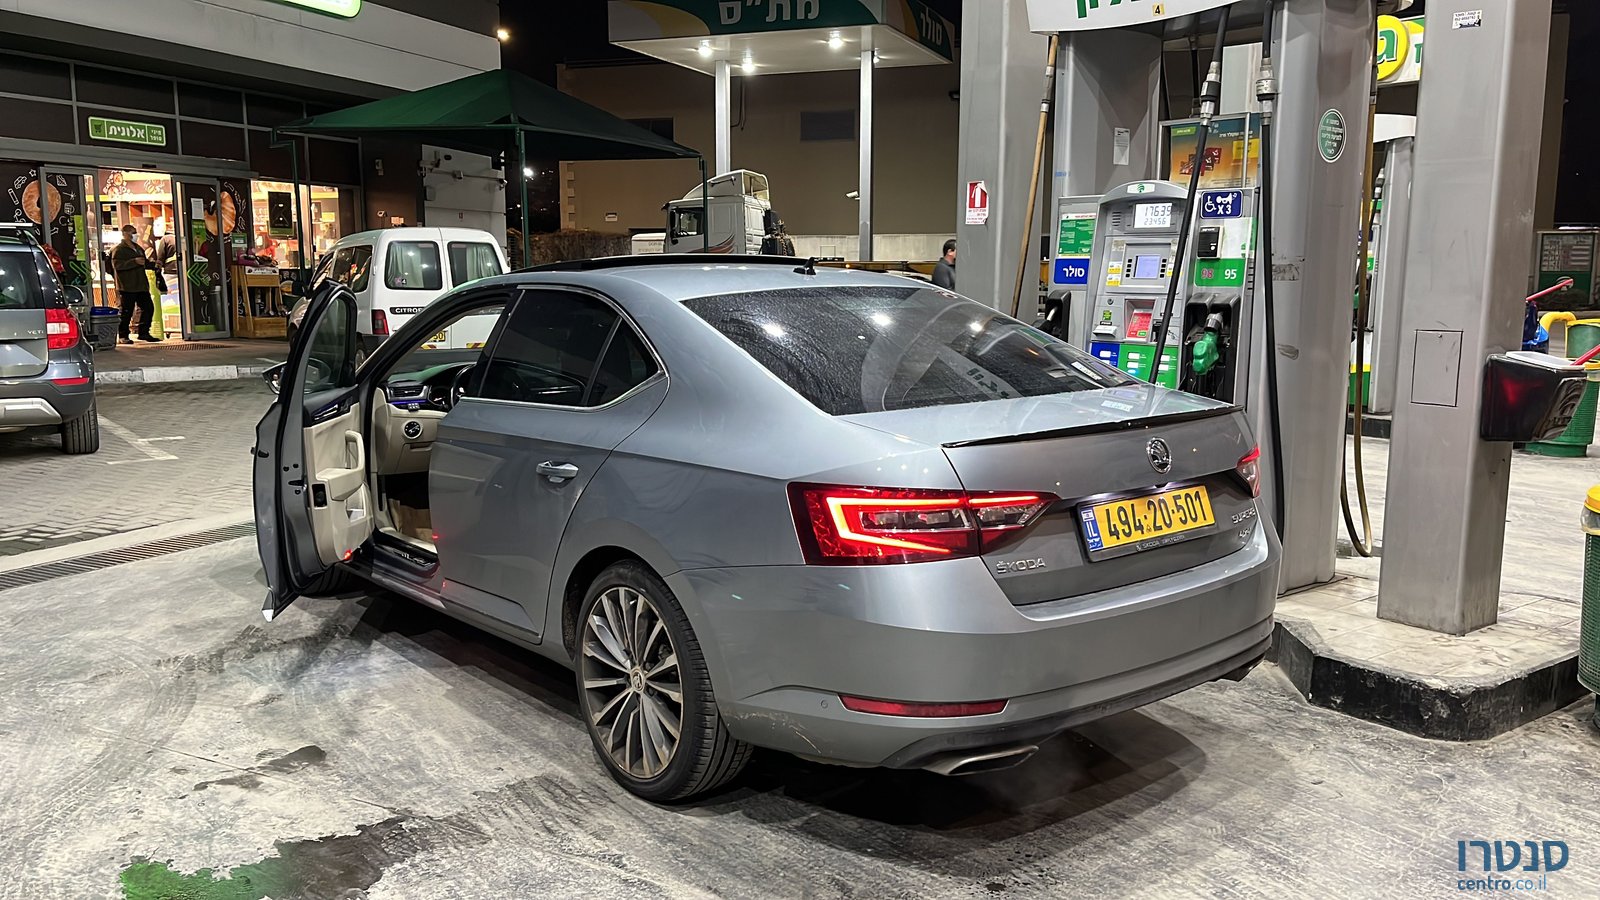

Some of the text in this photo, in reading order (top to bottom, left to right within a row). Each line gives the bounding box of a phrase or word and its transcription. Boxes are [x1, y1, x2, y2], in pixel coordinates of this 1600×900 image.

[1154, 5, 1161, 14] 4
[919, 7, 944, 46] סולר
[108, 125, 145, 139] אלונית
[1225, 205, 1232, 214] 3
[1062, 265, 1085, 278] סולר
[1224, 269, 1238, 280] 95
[1231, 507, 1256, 524] SUPERB
[1086, 521, 1098, 538] IL
[996, 557, 1047, 575] ŠKODA
